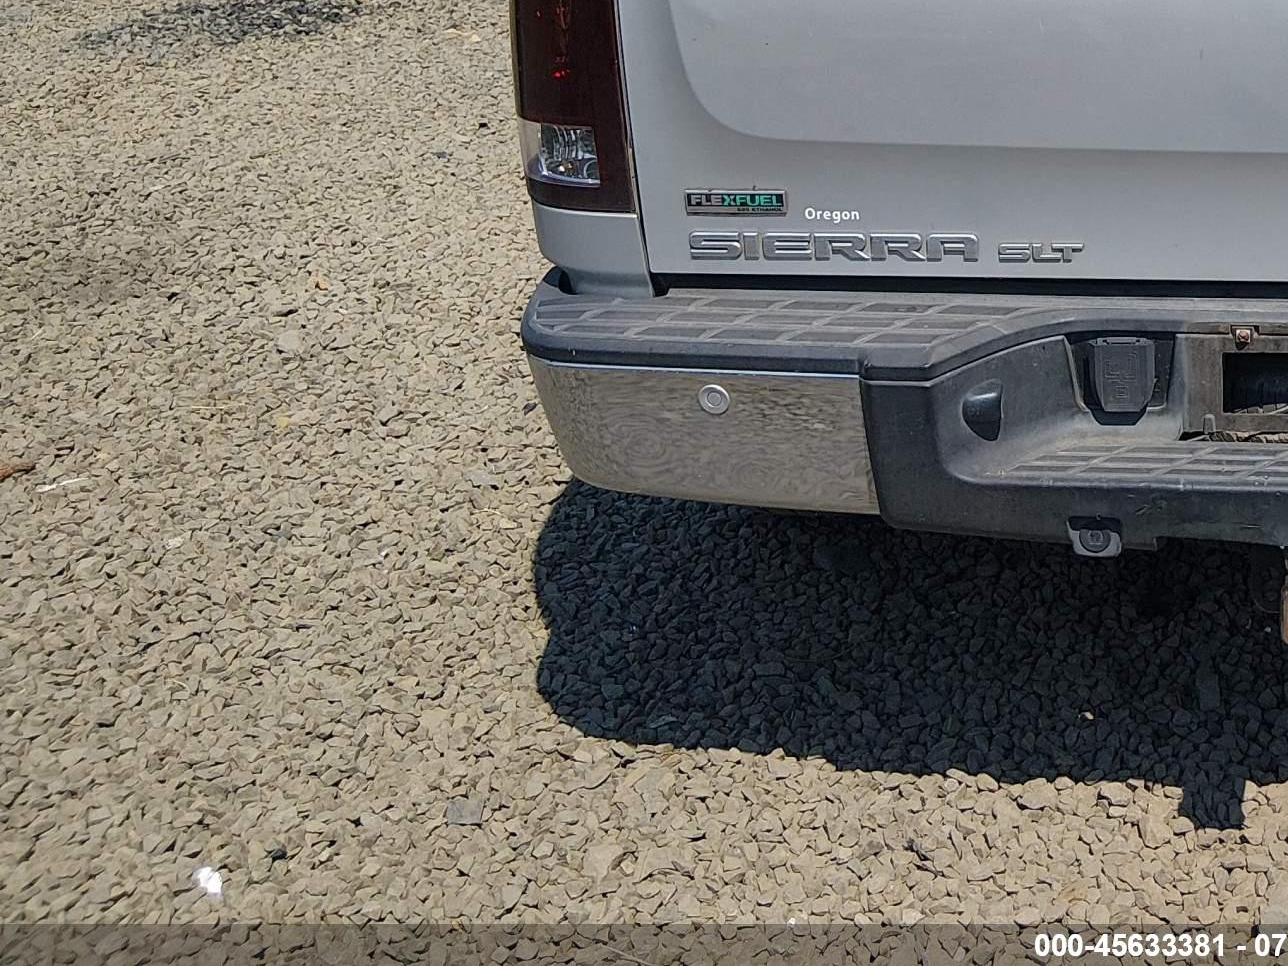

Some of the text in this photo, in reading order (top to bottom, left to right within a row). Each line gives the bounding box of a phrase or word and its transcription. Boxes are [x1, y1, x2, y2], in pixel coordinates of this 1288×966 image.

[690, 194, 782, 207] FLEXFUEL
[804, 207, 860, 224] Oregon
[688, 231, 1085, 263] SIERRA SLT
